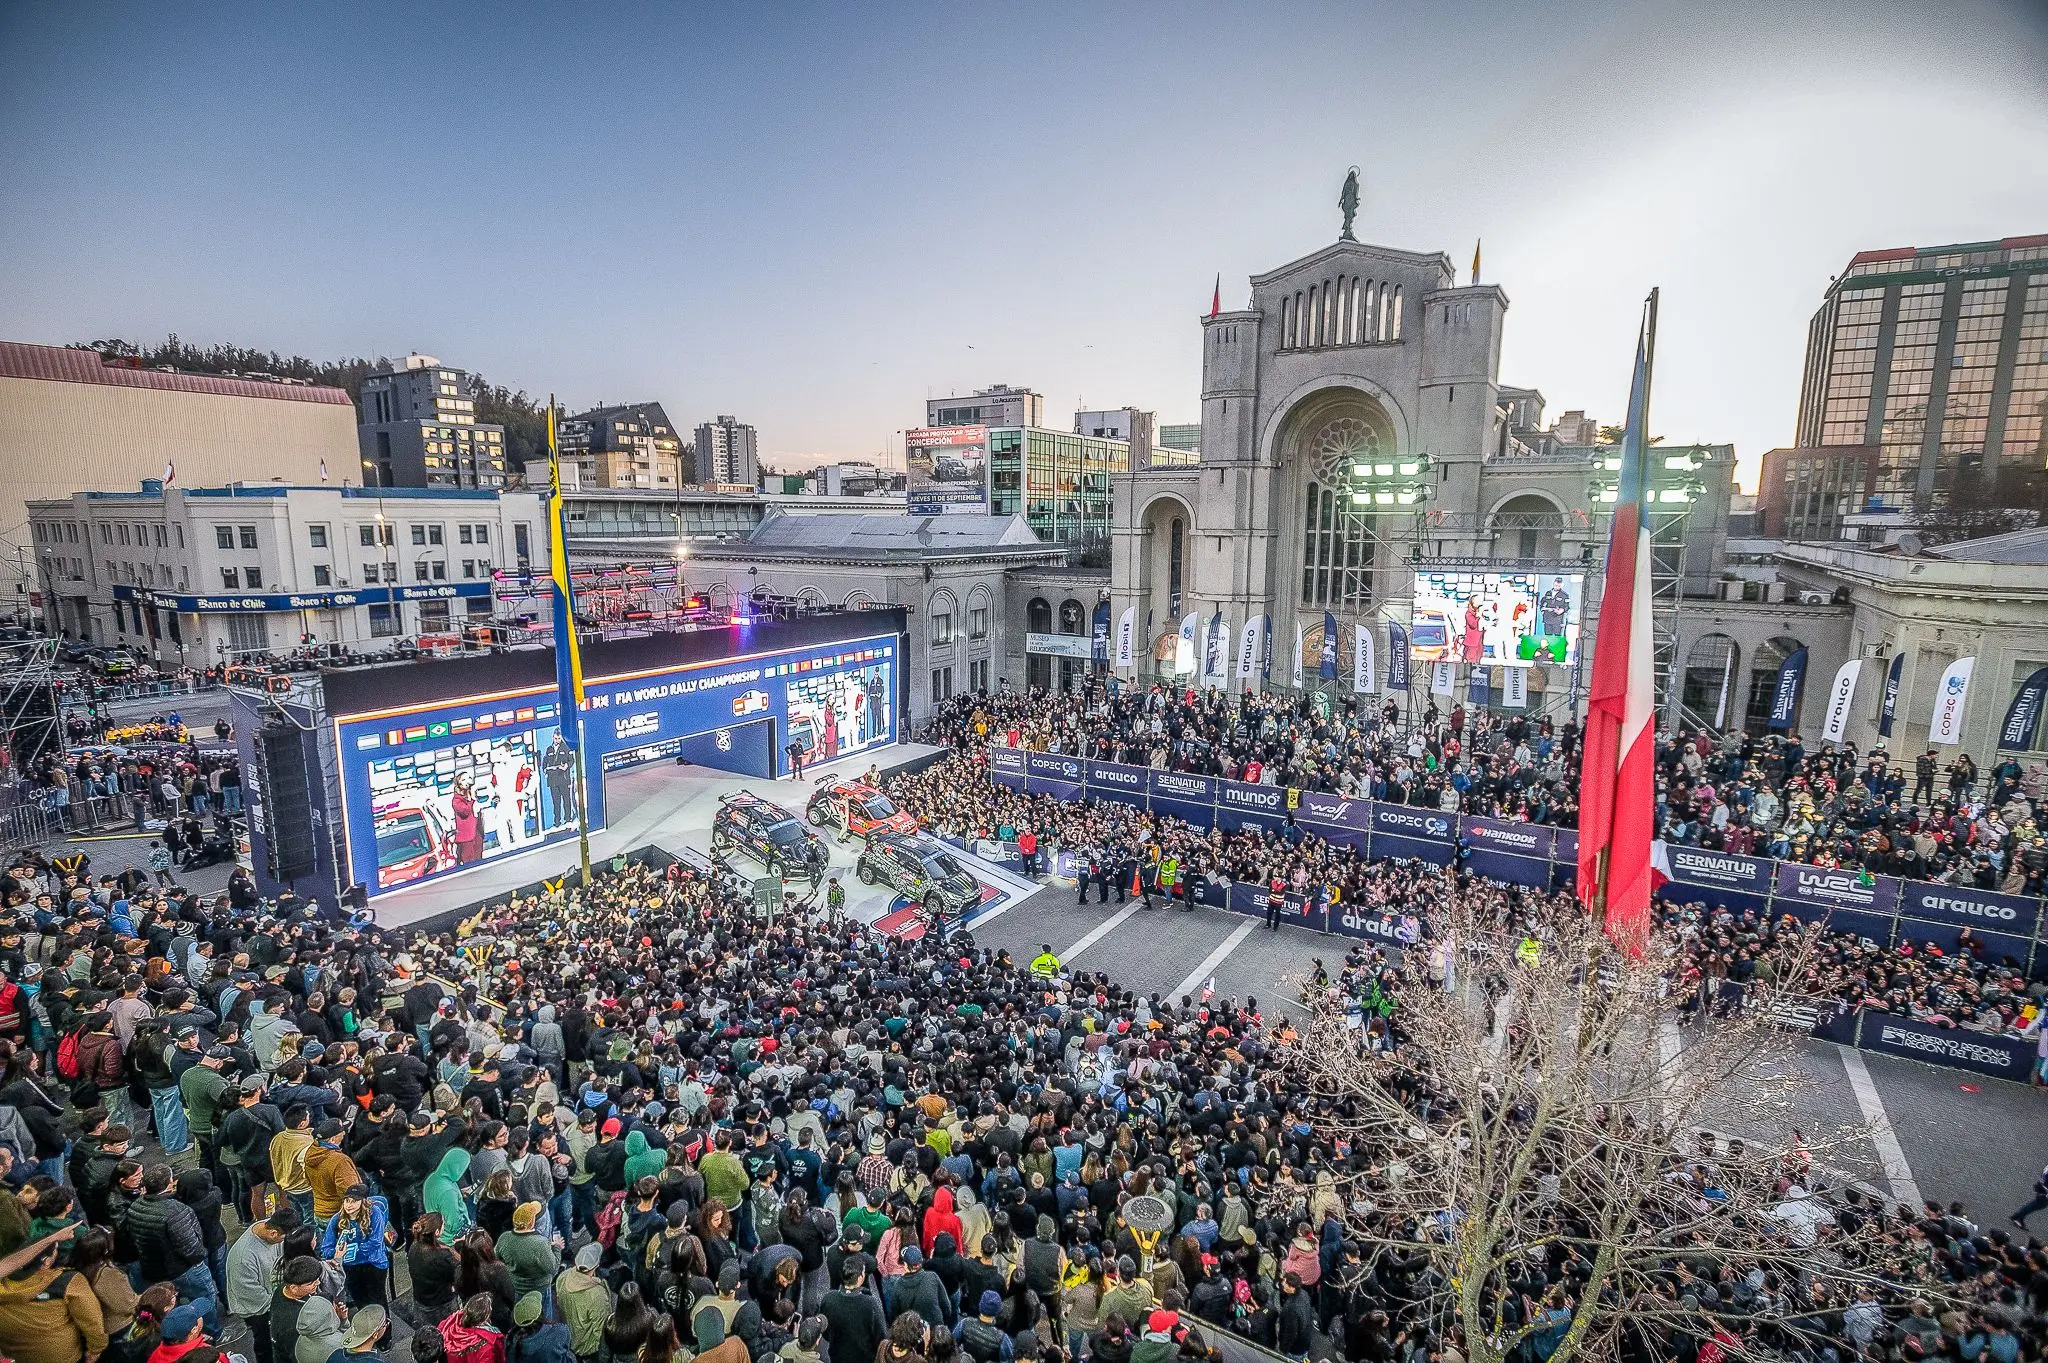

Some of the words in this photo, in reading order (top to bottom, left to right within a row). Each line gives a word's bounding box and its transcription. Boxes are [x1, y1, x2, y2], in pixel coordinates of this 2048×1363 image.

[907, 435, 952, 446] CONCEPCIÓN
[289, 596, 319, 607] Banco
[334, 595, 357, 605] Chile
[403, 588, 428, 598] Banco
[438, 587, 457, 596] Chile
[197, 596, 228, 609] Banco
[229, 599, 240, 609] de
[242, 599, 266, 609] Chile
[1242, 629, 1255, 672] arauco
[615, 692, 633, 705] FIA
[633, 685, 668, 703] WORLD
[670, 680, 698, 695] RALLY
[698, 670, 761, 690] CHAMPIONSHIP
[1772, 669, 1795, 719] SERNATUR
[1830, 678, 1849, 734] arauco
[2005, 687, 2037, 742] SERNATUR
[615, 711, 659, 729] WRC
[1941, 698, 1955, 736] COPEC
[1031, 758, 1061, 770] COPEC
[1095, 768, 1138, 784] arauco
[1158, 774, 1206, 790] SERNATUR
[1380, 812, 1422, 828] COPEC
[1676, 853, 1757, 875] SERNATUR
[1798, 871, 1875, 895] WRC
[1253, 894, 1300, 911] SERTUR
[1921, 894, 2017, 920] arauco
[1341, 914, 1404, 940] arauc
